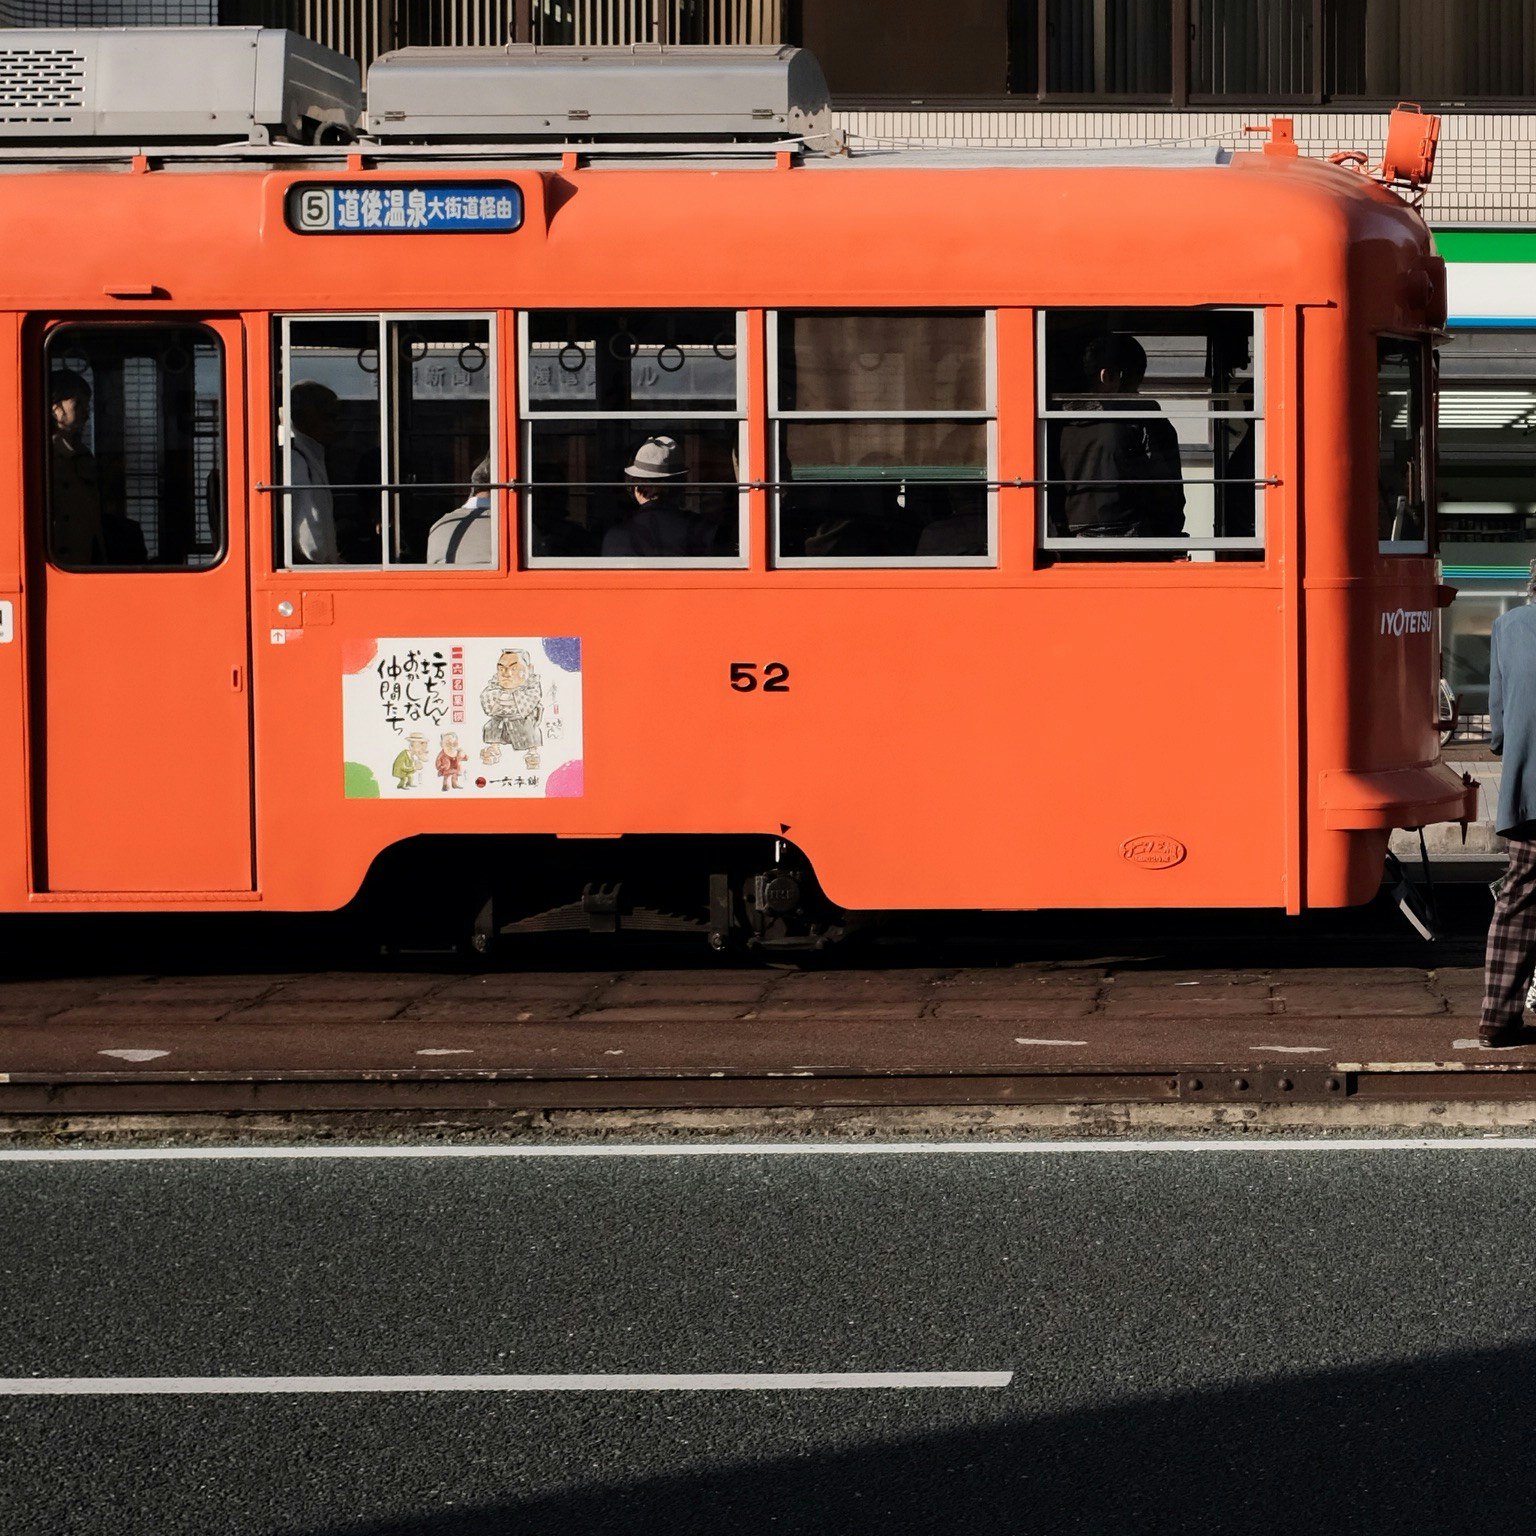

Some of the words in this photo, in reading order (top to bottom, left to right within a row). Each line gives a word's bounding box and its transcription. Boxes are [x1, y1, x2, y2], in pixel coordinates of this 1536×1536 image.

[305, 196, 324, 221] 5
[338, 189, 428, 228] 道後温泉
[428, 196, 512, 221] 大街道経由
[1380, 608, 1432, 637] IYOTETSU
[377, 655, 404, 736] 仲間たち
[403, 649, 422, 721] おかしな
[730, 662, 790, 692] 52
